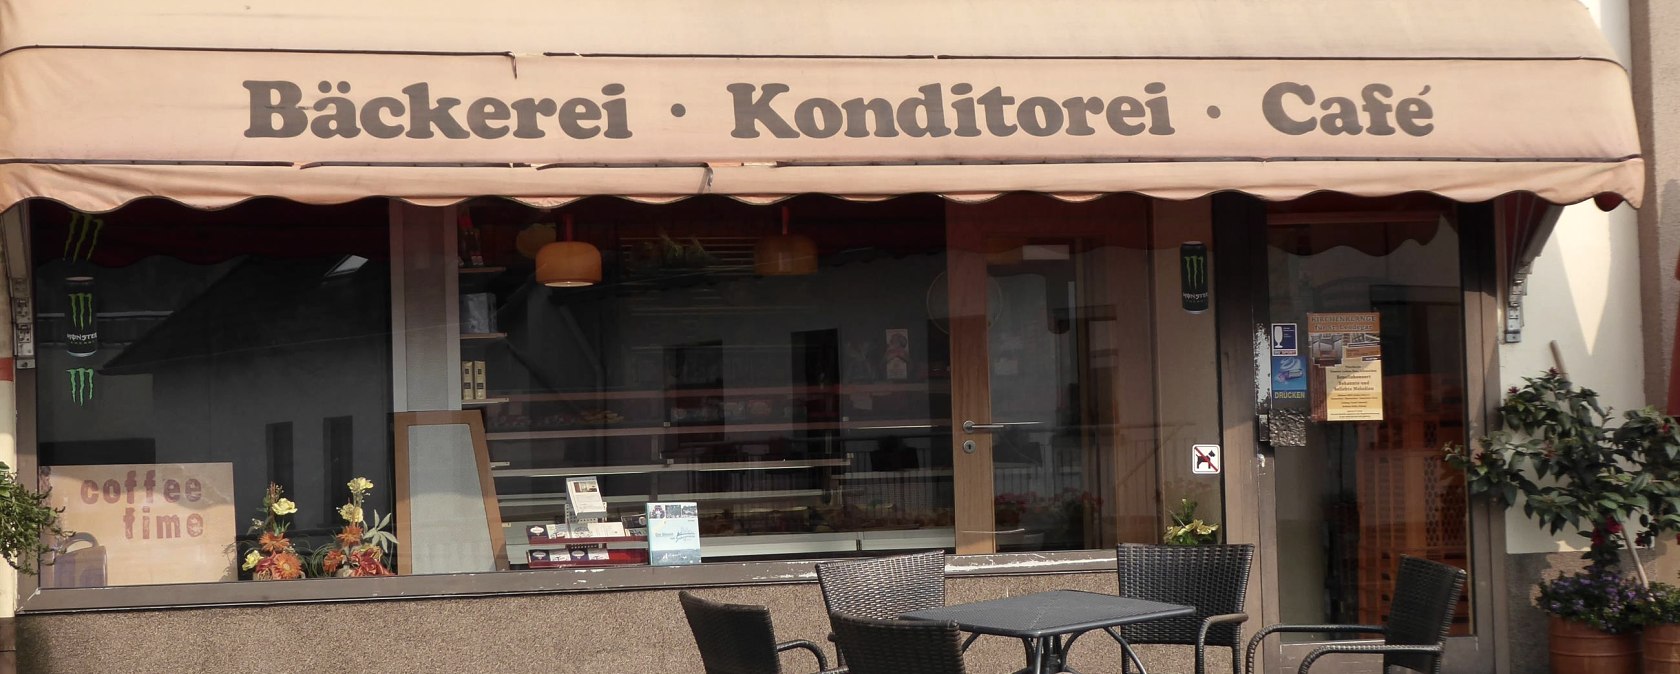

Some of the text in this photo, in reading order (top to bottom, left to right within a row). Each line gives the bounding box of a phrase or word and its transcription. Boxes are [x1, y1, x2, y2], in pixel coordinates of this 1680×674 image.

[242, 80, 1434, 139] Bäckerei Konditorei Café
[67, 332, 97, 341] MONSTER
[80, 470, 201, 504] coffee
[123, 507, 204, 540] time
